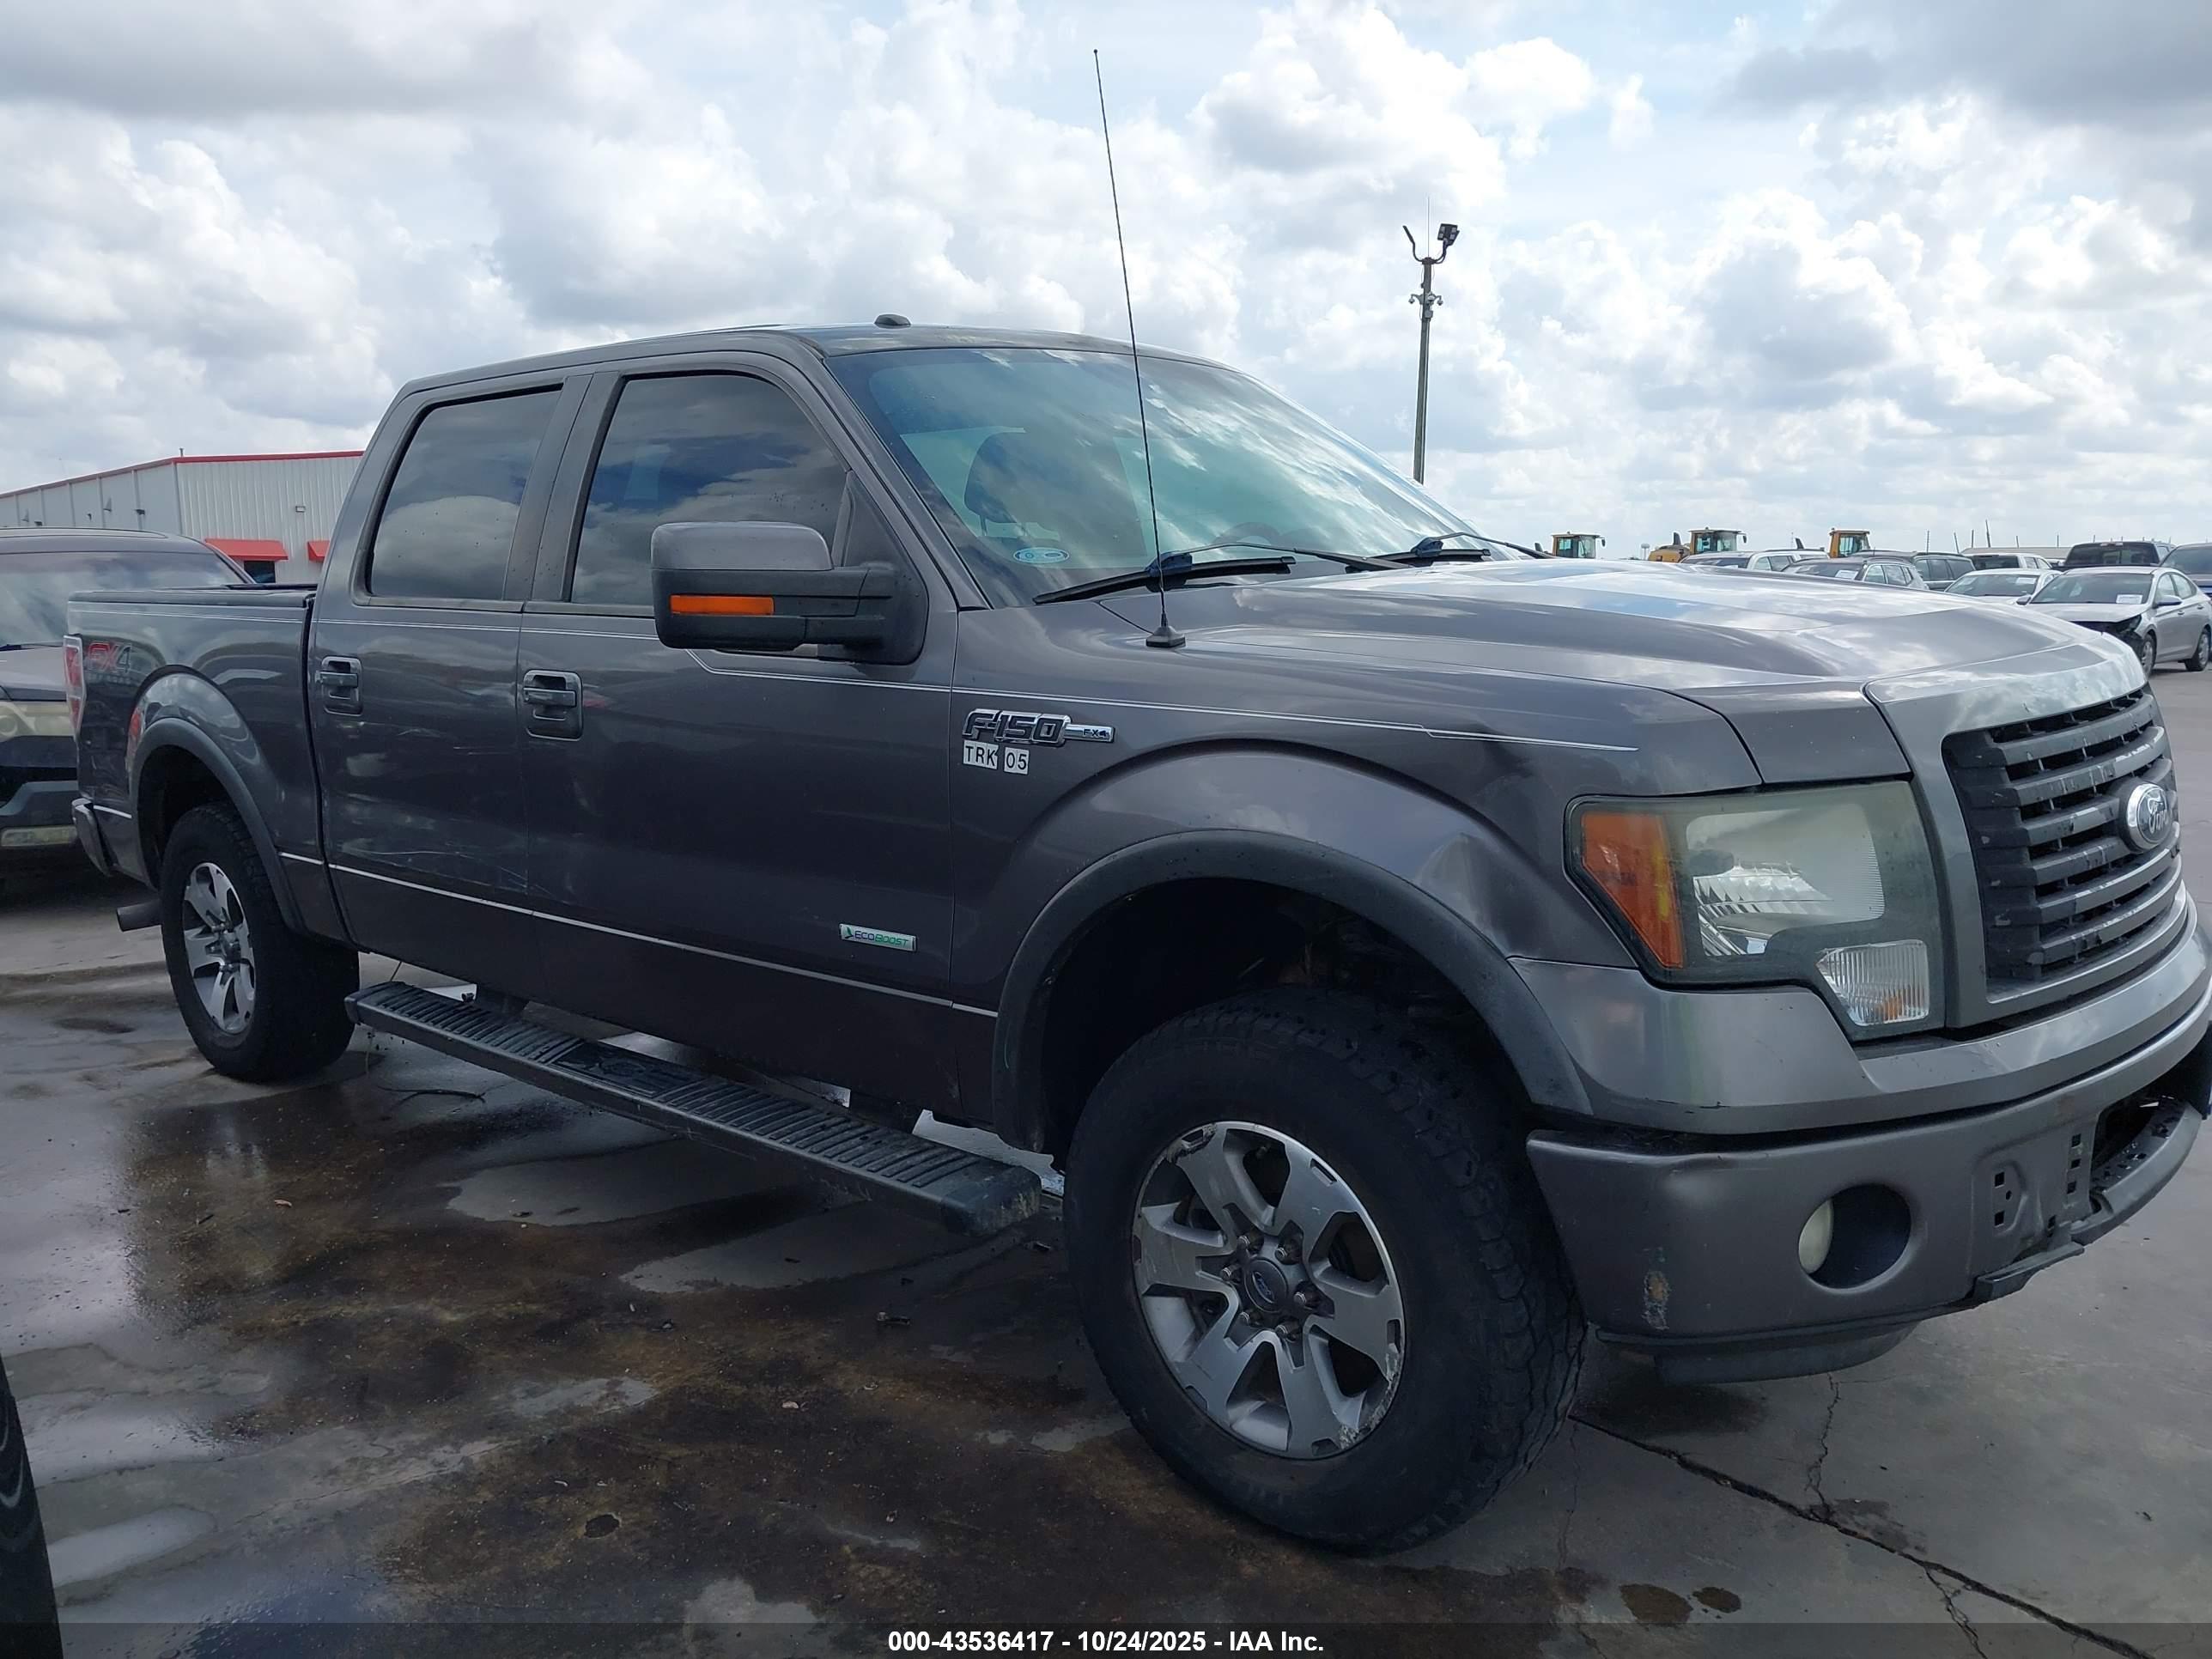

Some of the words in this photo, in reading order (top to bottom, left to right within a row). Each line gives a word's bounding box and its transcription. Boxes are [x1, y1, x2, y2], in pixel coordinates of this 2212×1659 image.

[962, 708, 1072, 746] F-150
[1082, 728, 1108, 738] FX4
[964, 744, 998, 767] TRK
[1006, 752, 1028, 771] 05
[854, 930, 908, 948] ECOBOOST
